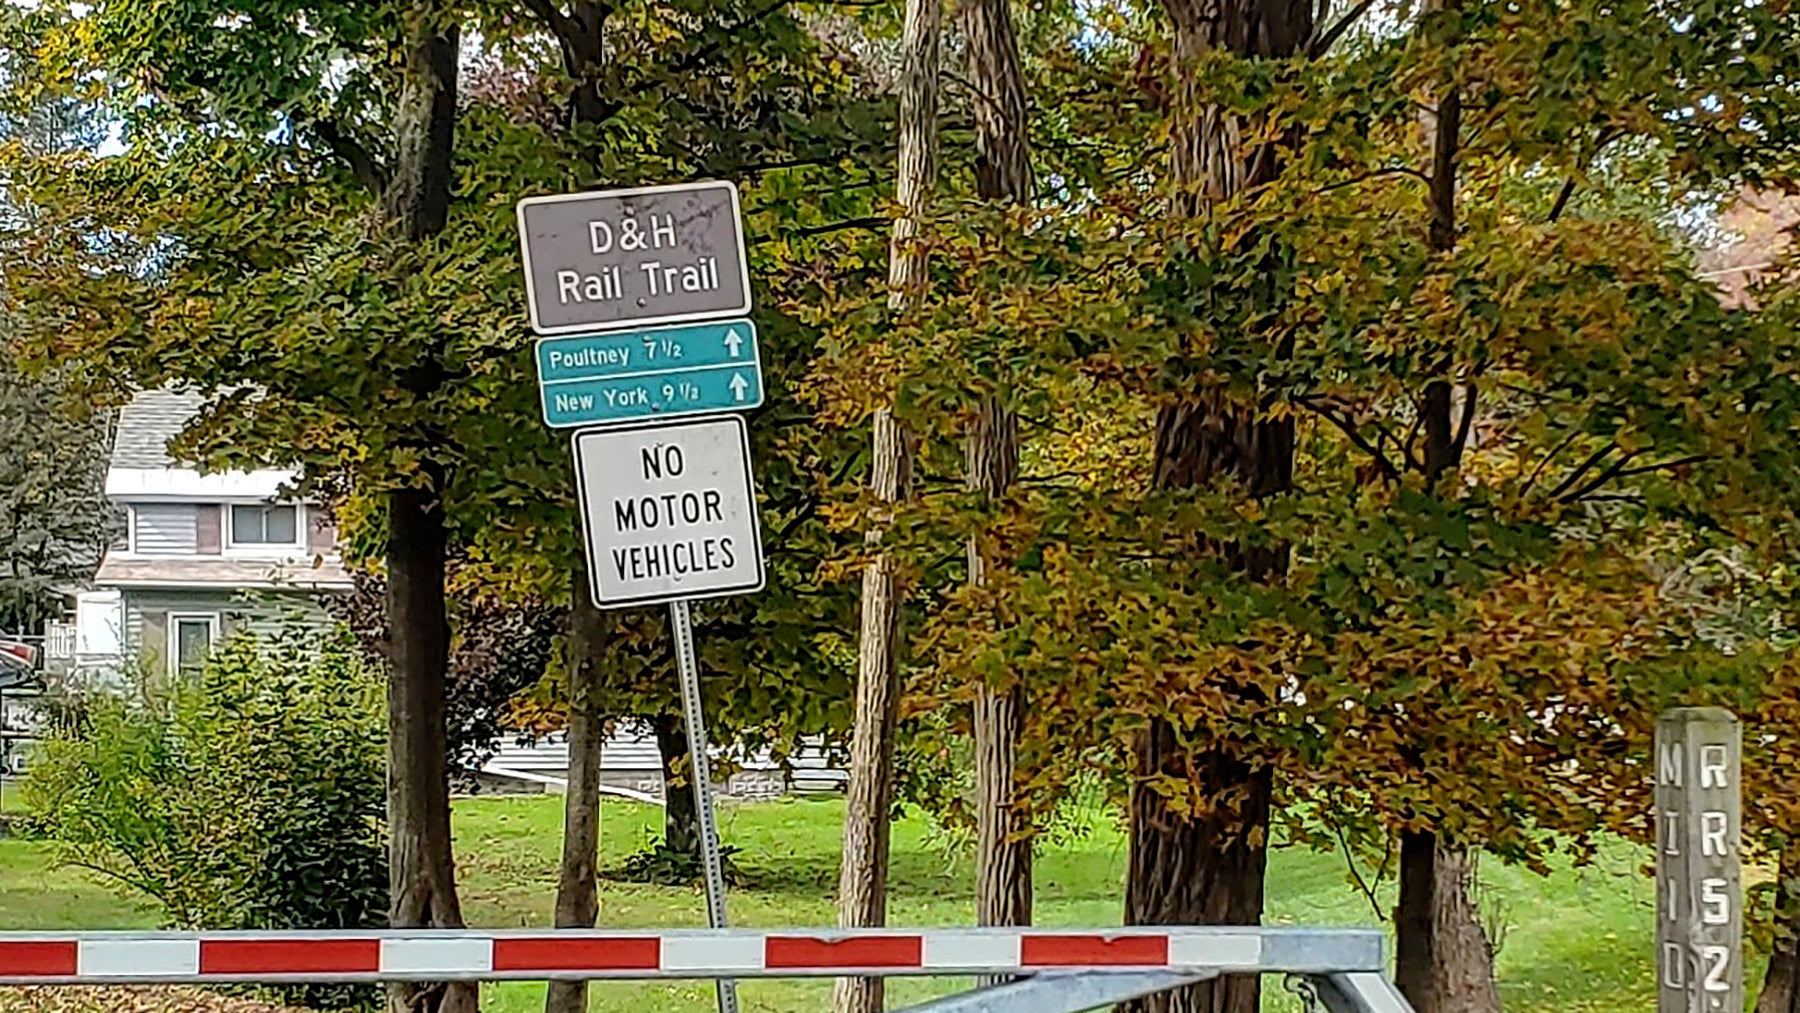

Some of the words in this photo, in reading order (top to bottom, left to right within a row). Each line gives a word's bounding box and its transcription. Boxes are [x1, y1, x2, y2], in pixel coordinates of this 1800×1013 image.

[589, 214, 676, 254] D&H
[557, 266, 622, 303] Rail
[641, 257, 719, 296] Trail
[549, 347, 630, 369] Poultney
[555, 394, 593, 412] New
[604, 387, 648, 406] York
[642, 445, 684, 480] NO
[614, 490, 723, 532] MOTOR
[612, 538, 735, 581] VEHICLES
